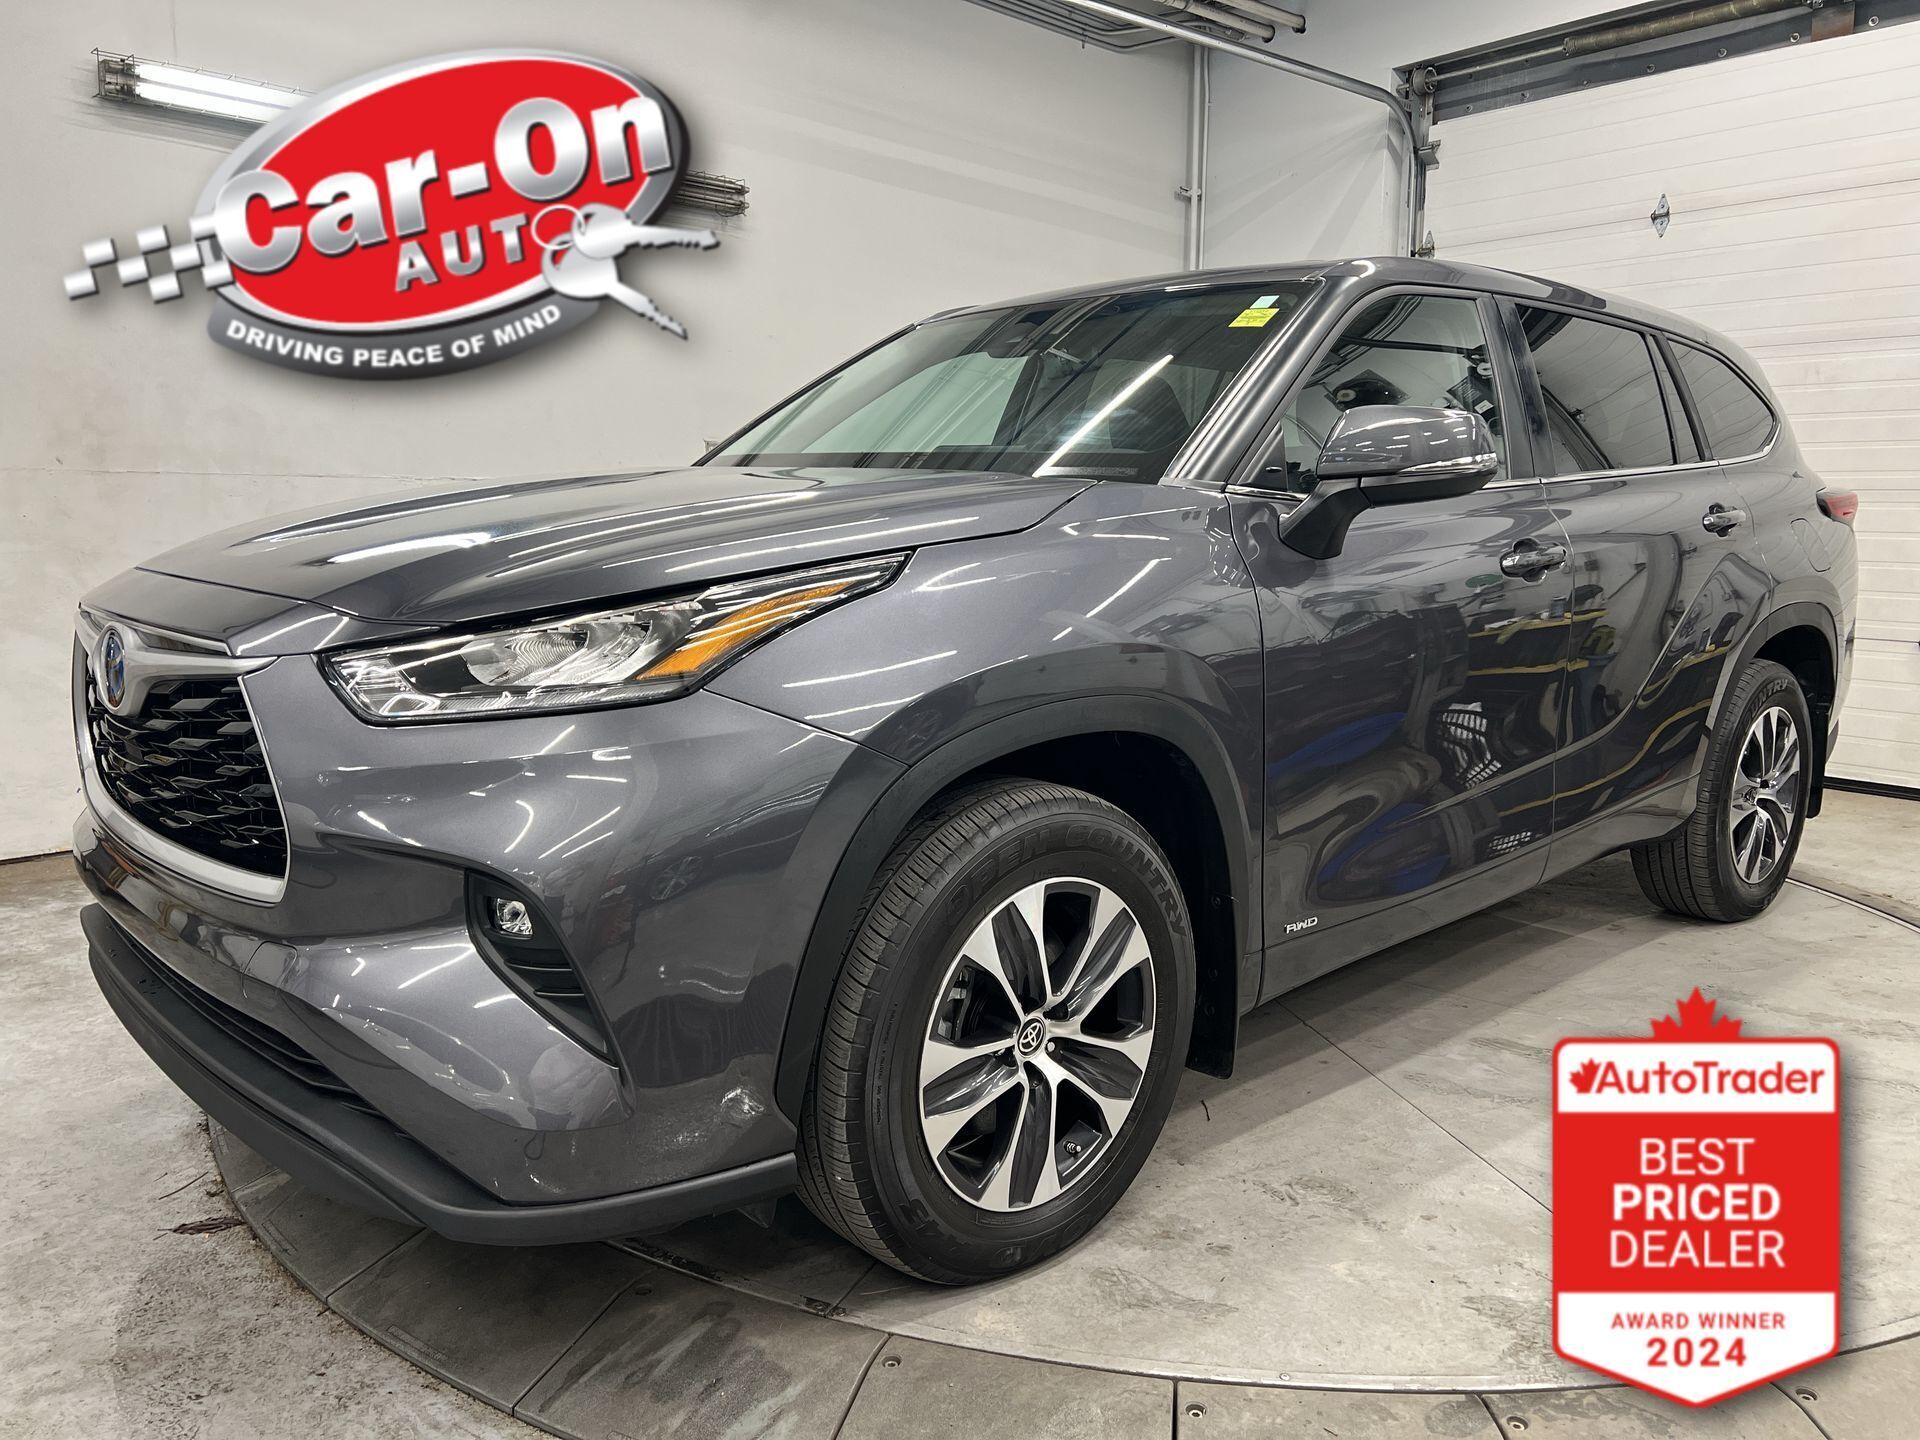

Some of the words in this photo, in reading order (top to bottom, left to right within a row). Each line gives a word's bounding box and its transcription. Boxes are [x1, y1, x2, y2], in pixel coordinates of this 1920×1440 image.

[947, 828, 1050, 922] OPEN
[1064, 824, 1187, 937] COUNTRY
[1283, 916, 1319, 935] AWD
